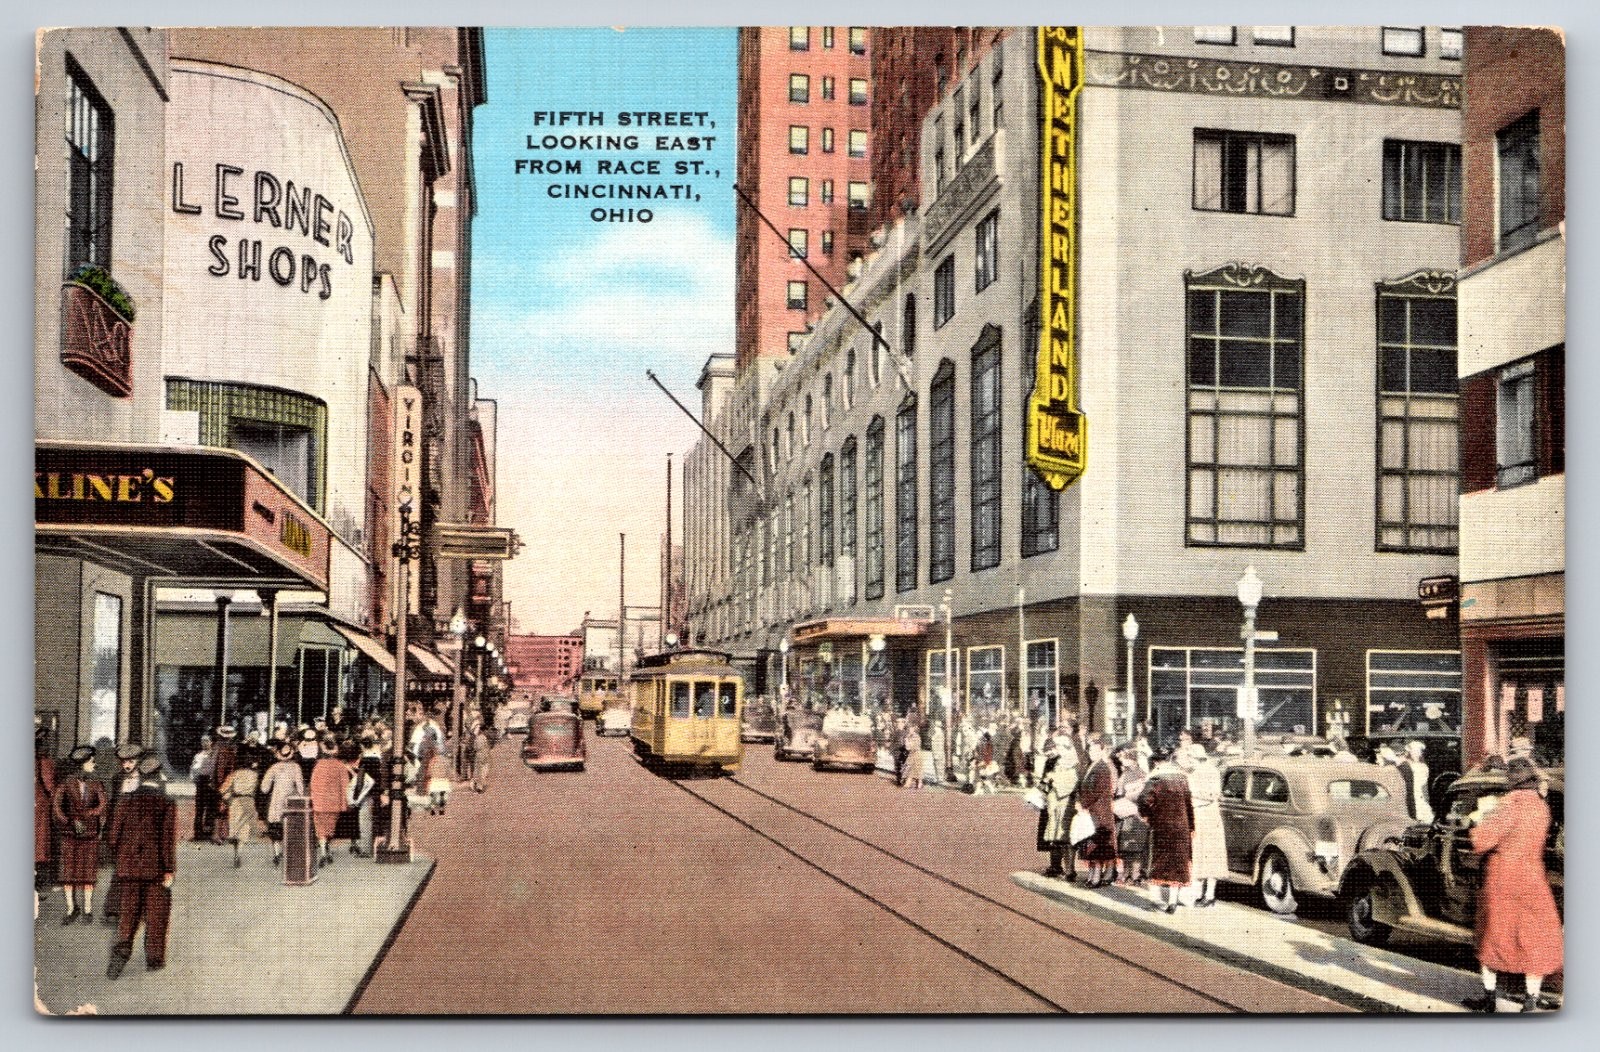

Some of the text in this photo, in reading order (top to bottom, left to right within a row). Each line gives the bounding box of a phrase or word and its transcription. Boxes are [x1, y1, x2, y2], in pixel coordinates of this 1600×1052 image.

[172, 162, 355, 264] LERNER
[1051, 45, 1072, 401] NETHERLAND
[208, 234, 333, 300] SHOPS
